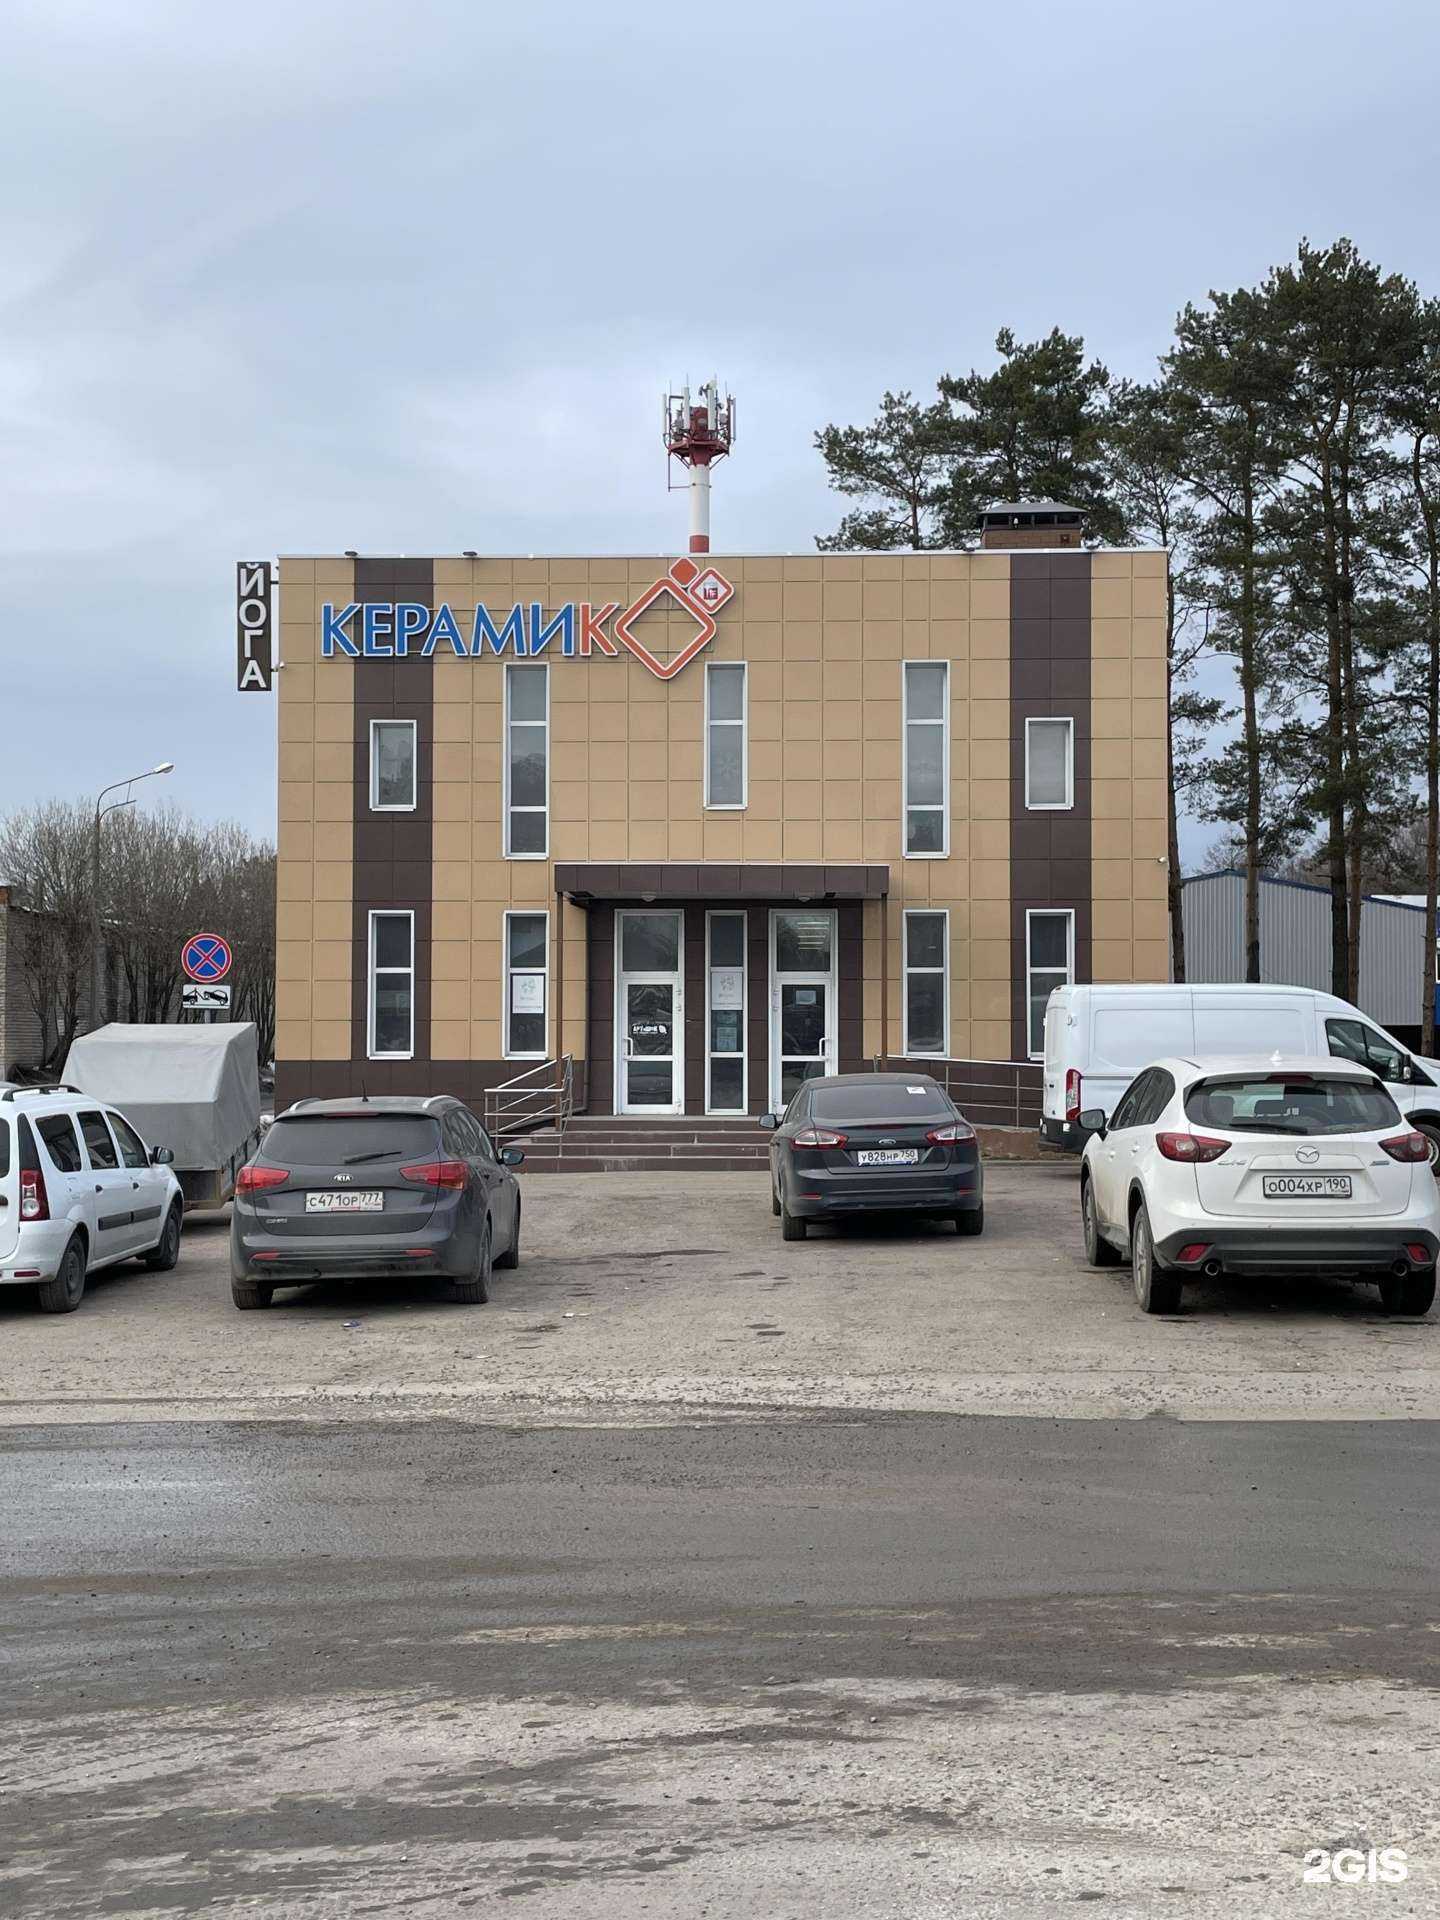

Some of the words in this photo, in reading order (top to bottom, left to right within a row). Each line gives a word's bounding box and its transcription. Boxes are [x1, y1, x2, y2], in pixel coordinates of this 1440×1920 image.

[239, 562, 267, 689] ЙОГА
[900, 1149, 915, 1158] 750
[1268, 1179, 1323, 1193] О004ХР
[1326, 1178, 1347, 1190] 190
[309, 1194, 358, 1207] С471ОР
[360, 1192, 379, 1202] 777
